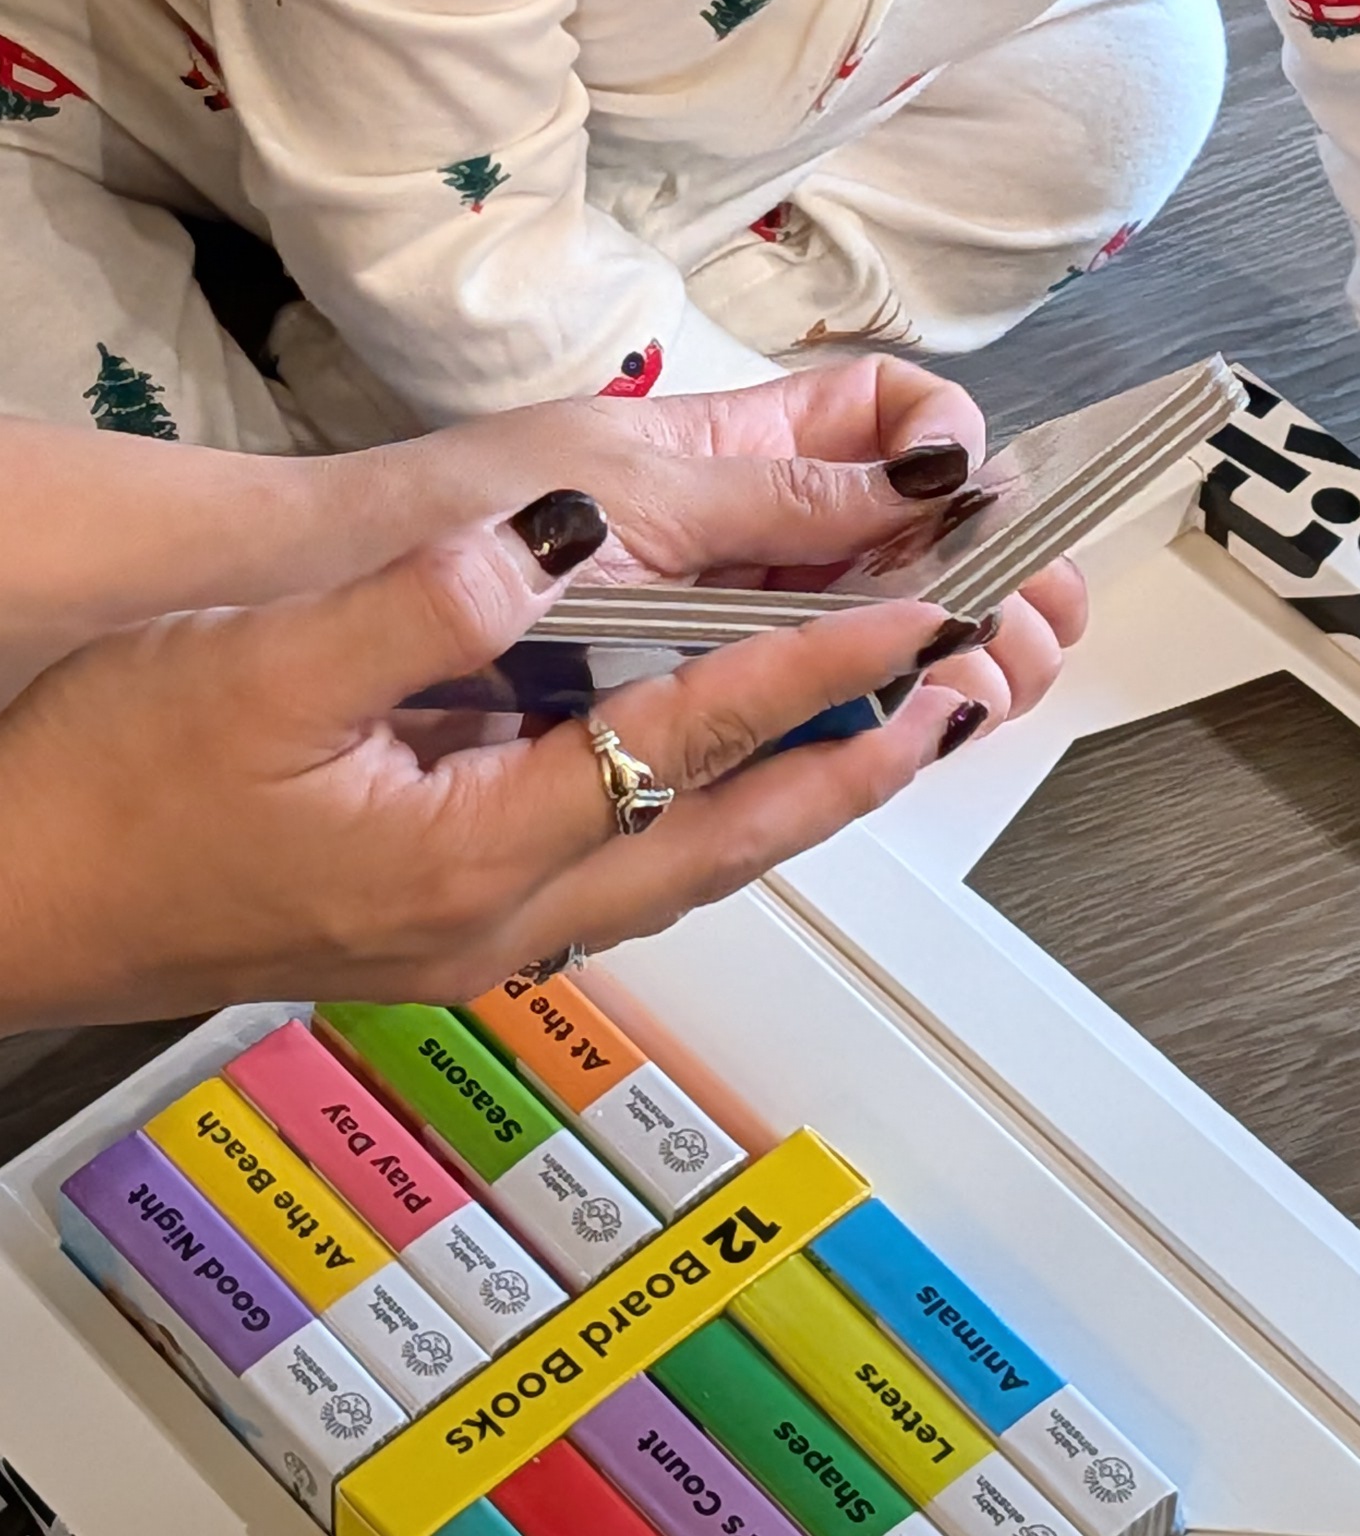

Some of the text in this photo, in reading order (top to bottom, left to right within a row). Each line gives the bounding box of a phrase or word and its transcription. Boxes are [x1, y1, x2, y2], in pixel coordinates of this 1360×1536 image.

[529, 996, 575, 1042] the
[570, 1037, 611, 1071] At
[417, 1037, 524, 1144] Seasons
[624, 1101, 656, 1133] baby
[196, 1110, 356, 1270] At the Beach
[320, 1103, 433, 1214] Play Day
[537, 1170, 570, 1202] baby
[127, 1182, 272, 1332] Good Night
[445, 1240, 478, 1273] baby
[367, 1301, 400, 1335] baby
[444, 1206, 783, 1455] 12 Board Books
[915, 1285, 1030, 1392] Animals
[287, 1361, 319, 1396] baby
[854, 1362, 956, 1464] Letters
[1045, 1425, 1081, 1459] baby
[636, 1429, 722, 1517] Count
[772, 1421, 877, 1524] Shapes
[971, 1492, 1006, 1527] baby
